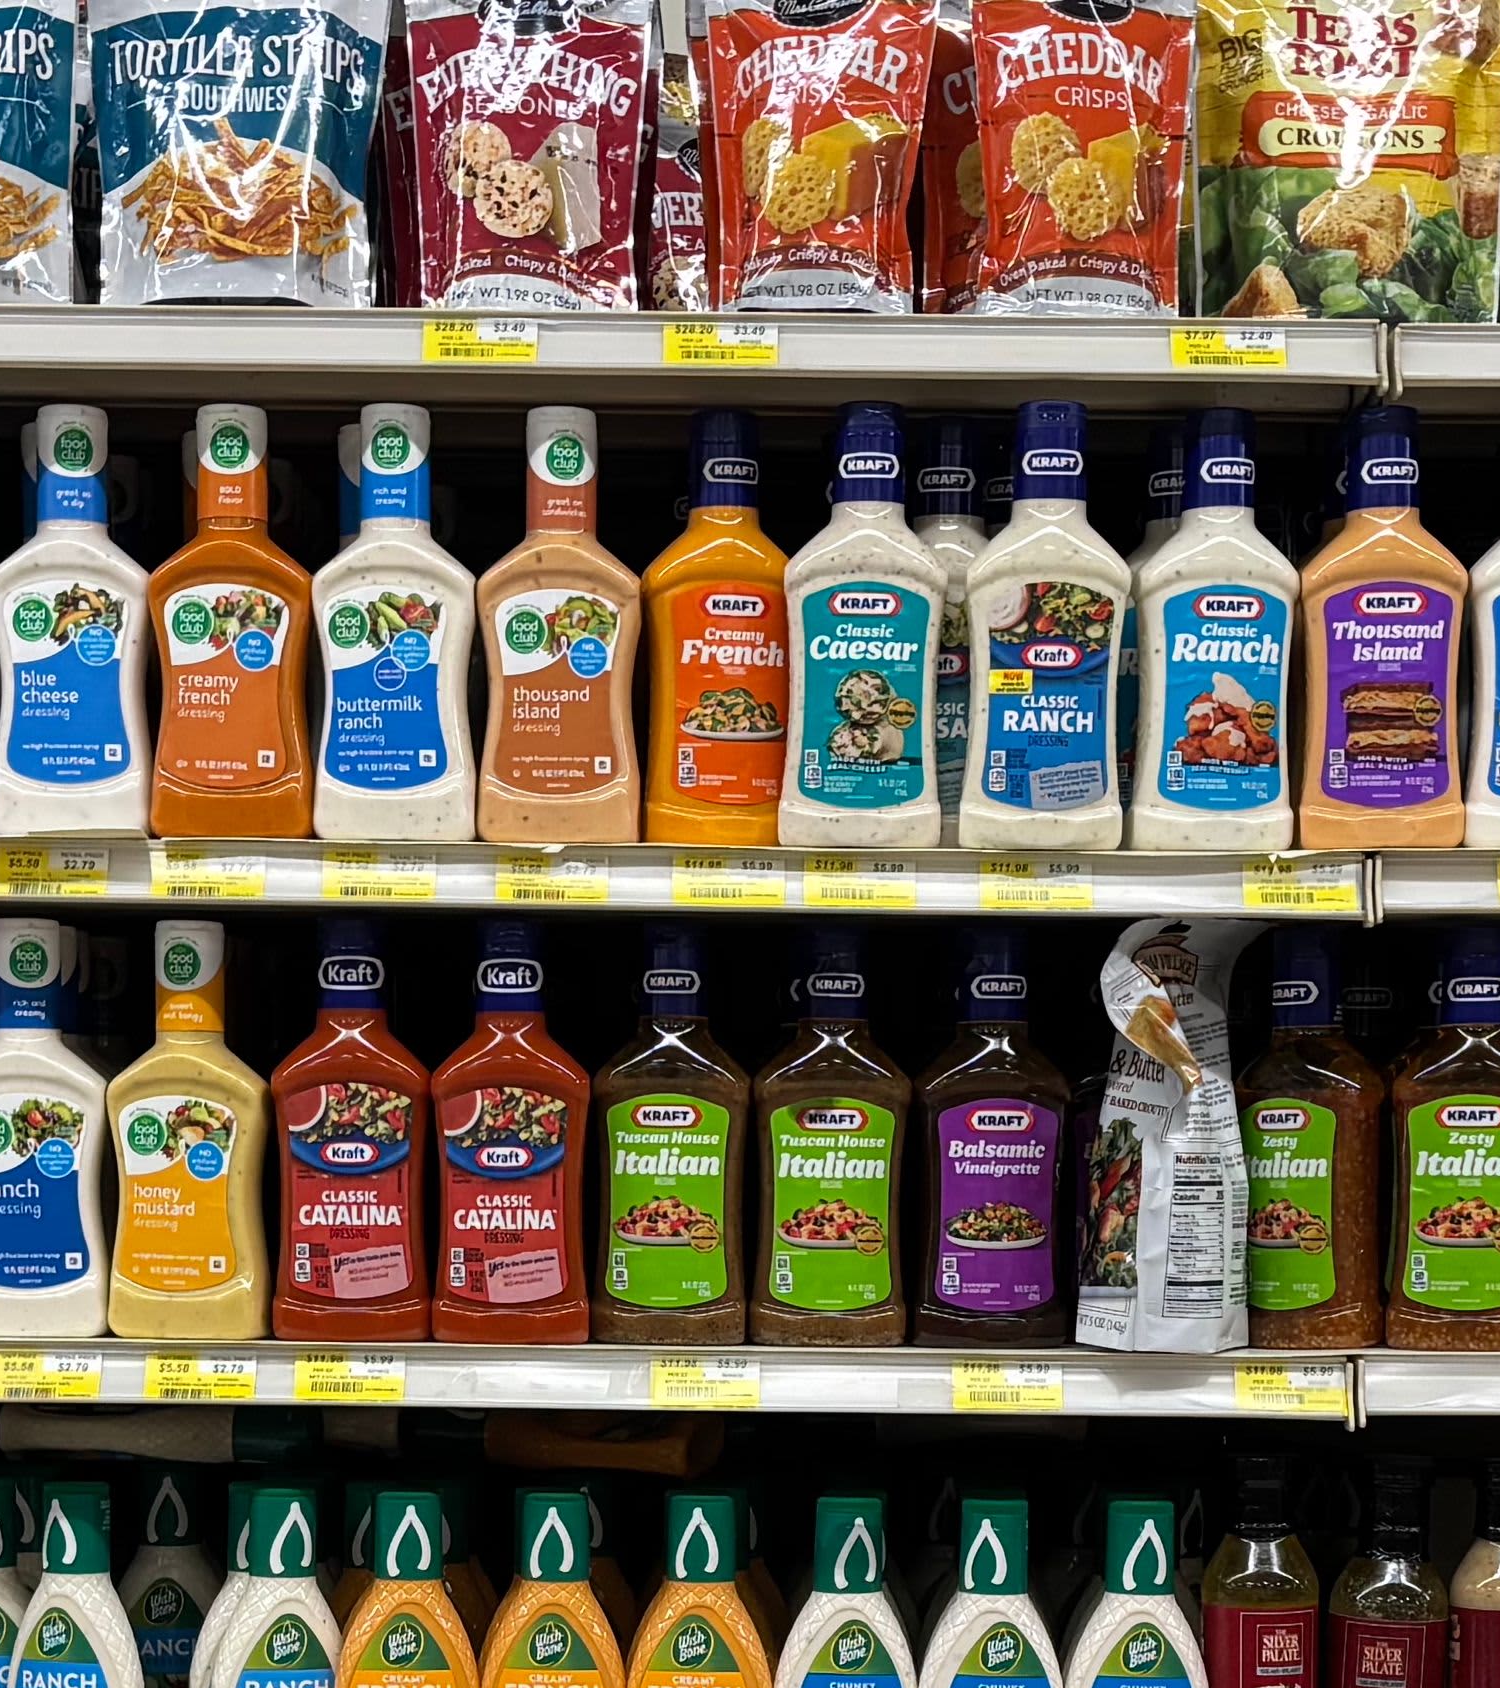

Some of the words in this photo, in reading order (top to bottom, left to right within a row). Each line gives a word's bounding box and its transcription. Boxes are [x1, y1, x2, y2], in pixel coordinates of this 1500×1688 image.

[1053, 84, 1130, 111] CRISPS
[1030, 455, 1076, 471] KRAFT
[835, 624, 894, 639] Classic
[1332, 620, 1444, 643] Thousand
[809, 637, 919, 663] Caesar
[1352, 641, 1424, 662] Island
[21, 670, 57, 688] blue
[21, 688, 80, 705] cheese
[336, 695, 423, 715] buttermilk
[338, 713, 383, 731] ranch
[1003, 710, 1093, 734] RANCH
[326, 962, 373, 984] Kraft
[616, 1132, 667, 1145] Tuscan
[672, 1131, 720, 1146] House
[948, 1140, 1045, 1161] Balsamic
[614, 1147, 720, 1177] Italian
[133, 1183, 181, 1203] honey
[133, 1199, 195, 1217] mustard
[299, 1204, 402, 1226] CATALINA
